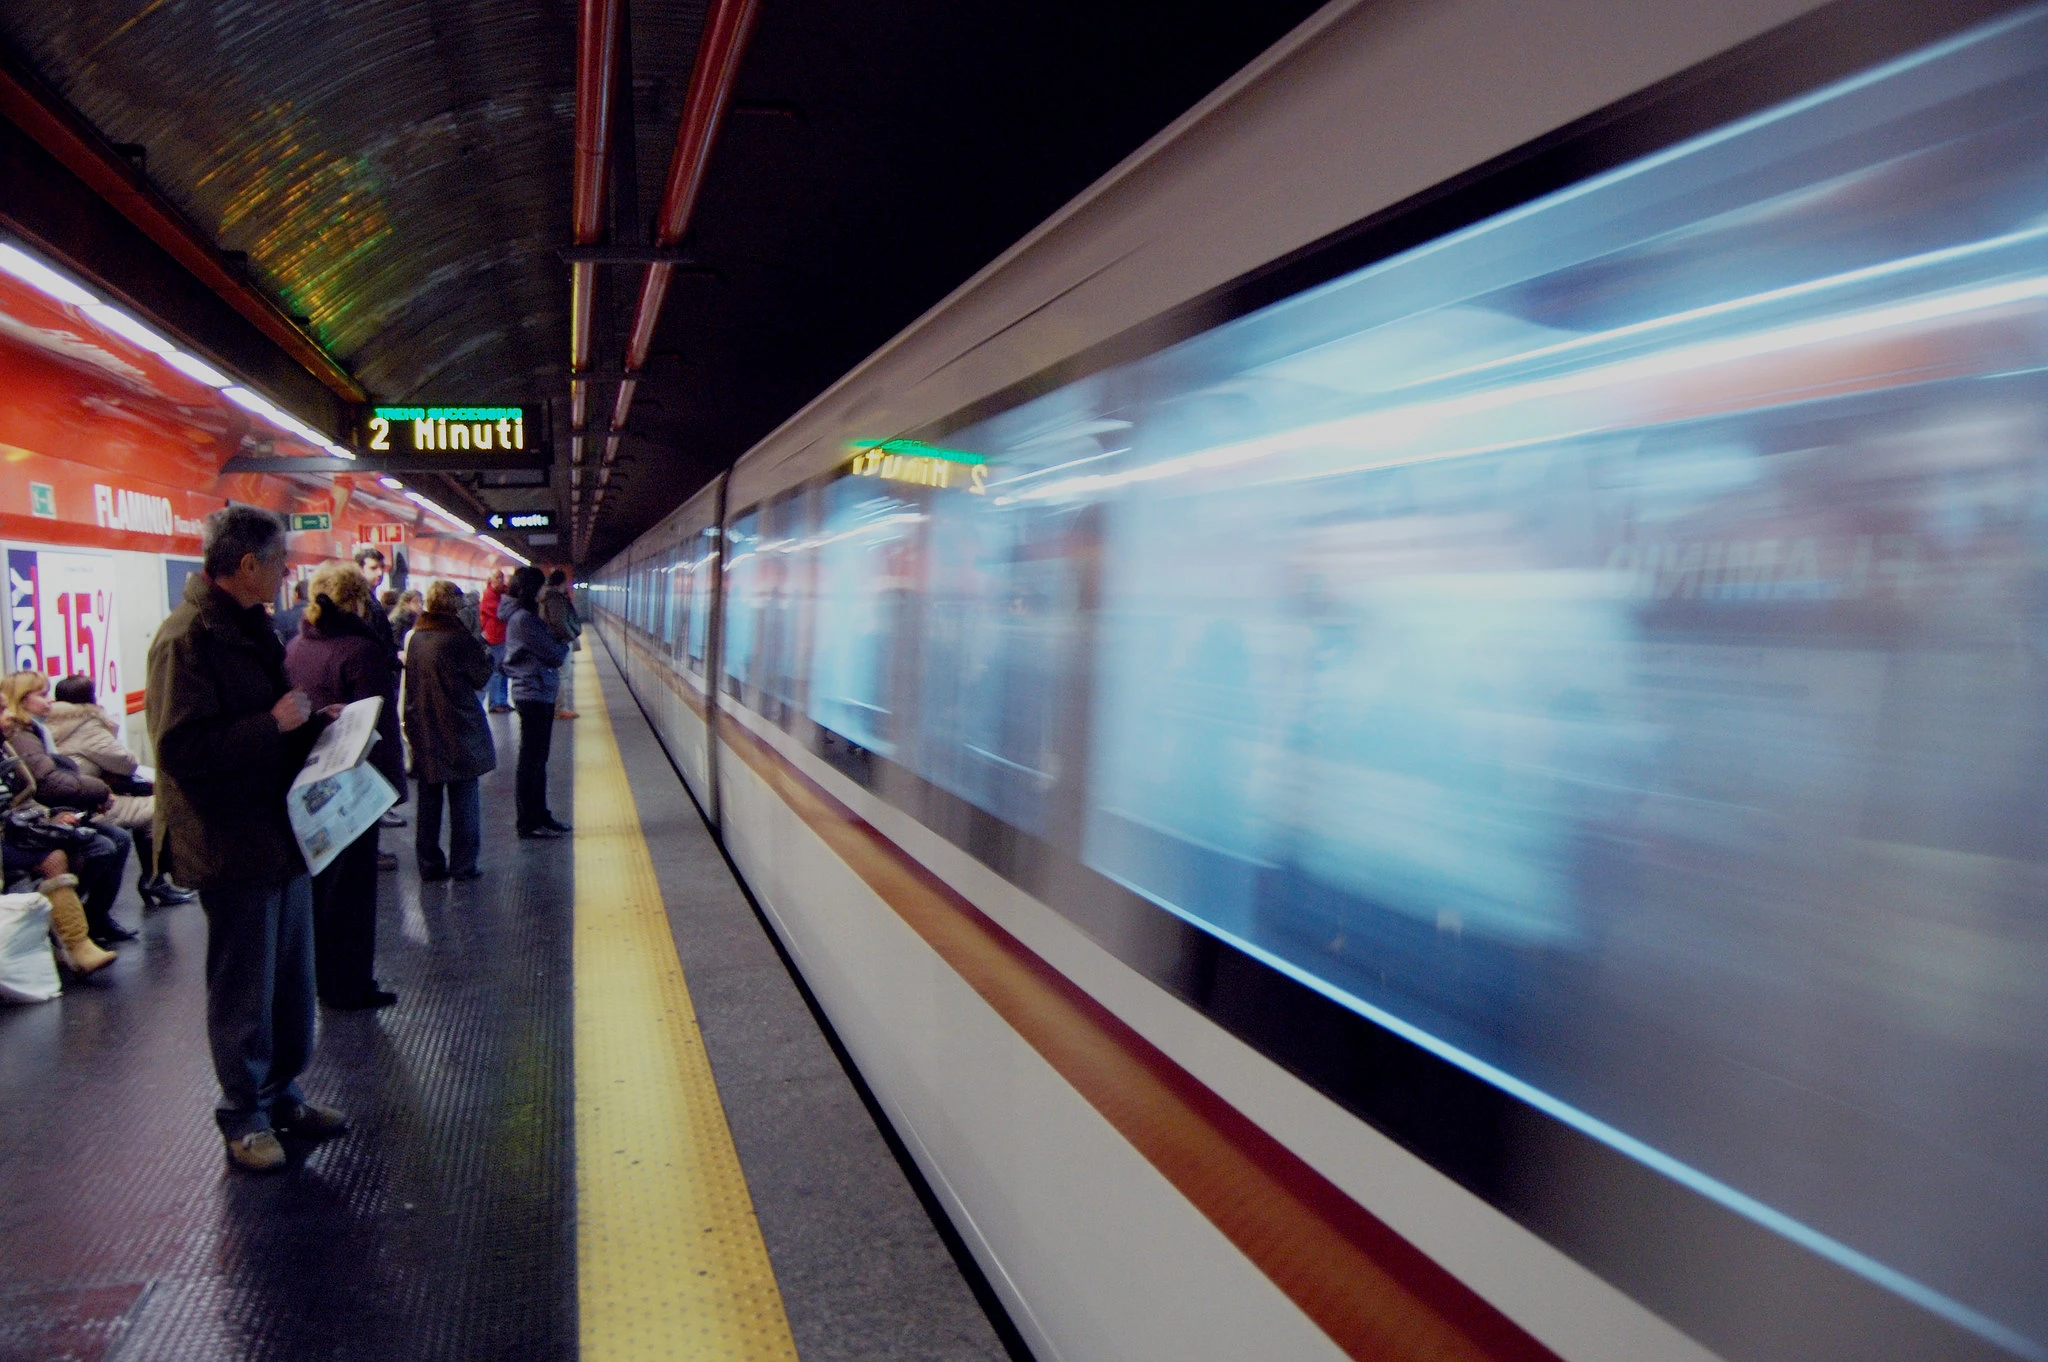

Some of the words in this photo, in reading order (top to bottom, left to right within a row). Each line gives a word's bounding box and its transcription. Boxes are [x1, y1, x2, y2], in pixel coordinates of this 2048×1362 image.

[370, 418, 390, 450] 2
[415, 417, 523, 450] Minuti
[94, 483, 173, 537] FLAMINIO
